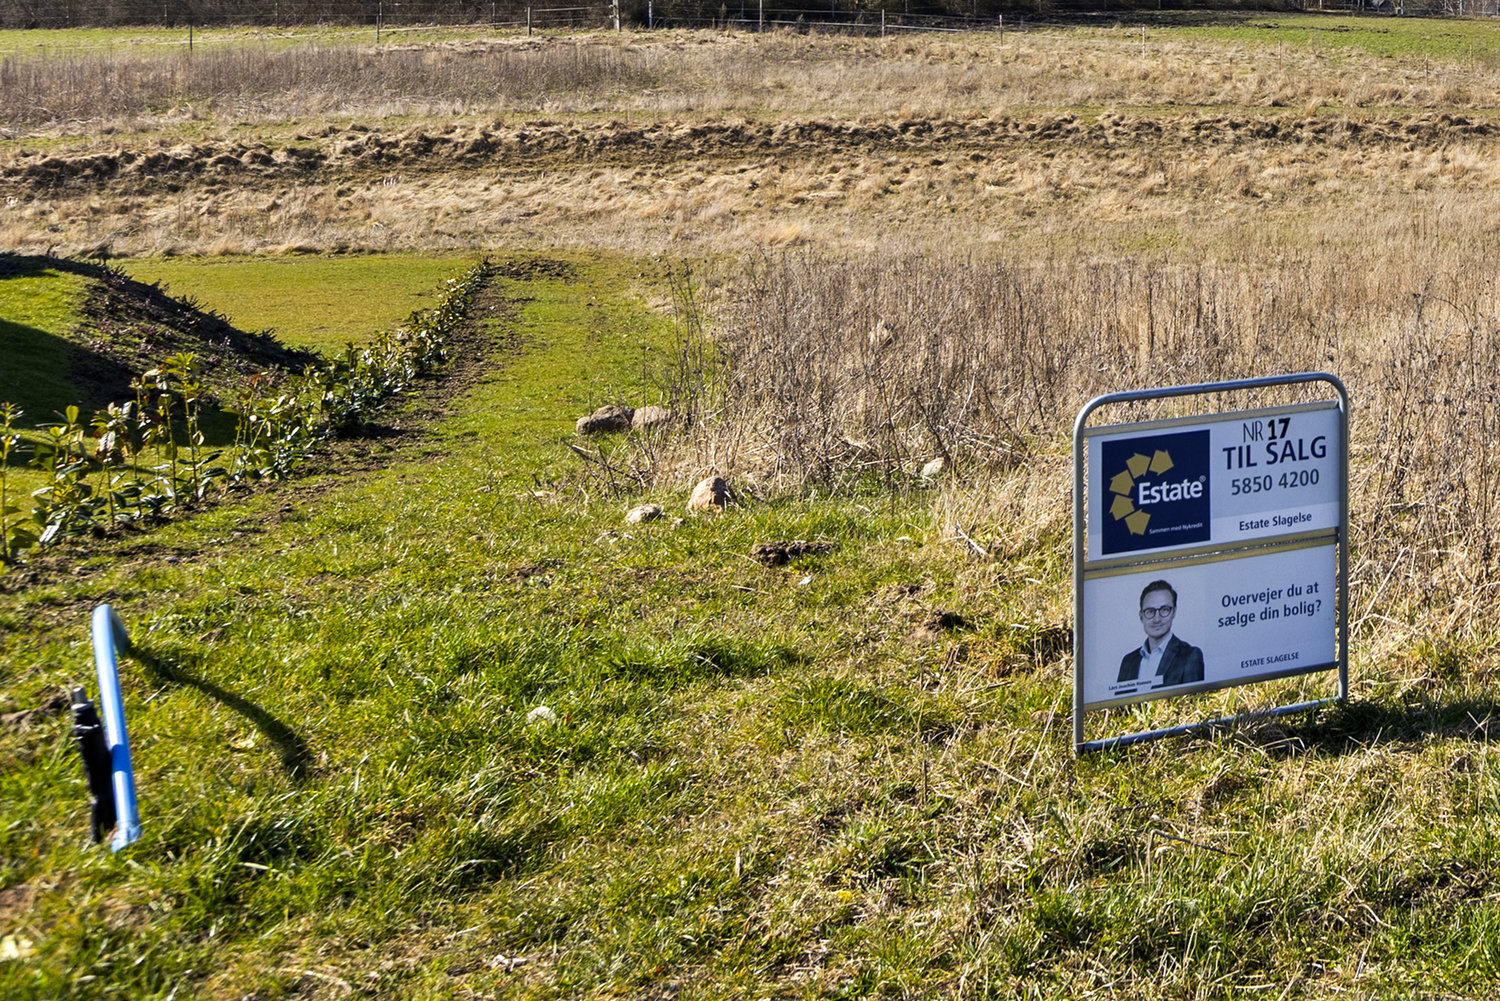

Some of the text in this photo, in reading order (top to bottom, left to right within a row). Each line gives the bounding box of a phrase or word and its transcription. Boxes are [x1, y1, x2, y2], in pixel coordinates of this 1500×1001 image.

[1243, 417, 1291, 443] NR 17
[1223, 435, 1327, 470] TIL SALG
[1138, 477, 1203, 505] Estate
[1231, 468, 1320, 496] 5850 4200
[1239, 511, 1313, 532] Estate Slagelse
[1221, 581, 1320, 608] Overvejer du at
[1218, 599, 1322, 628] sælge din bolig?
[1240, 651, 1300, 669] ESTATE SLAGELSE
